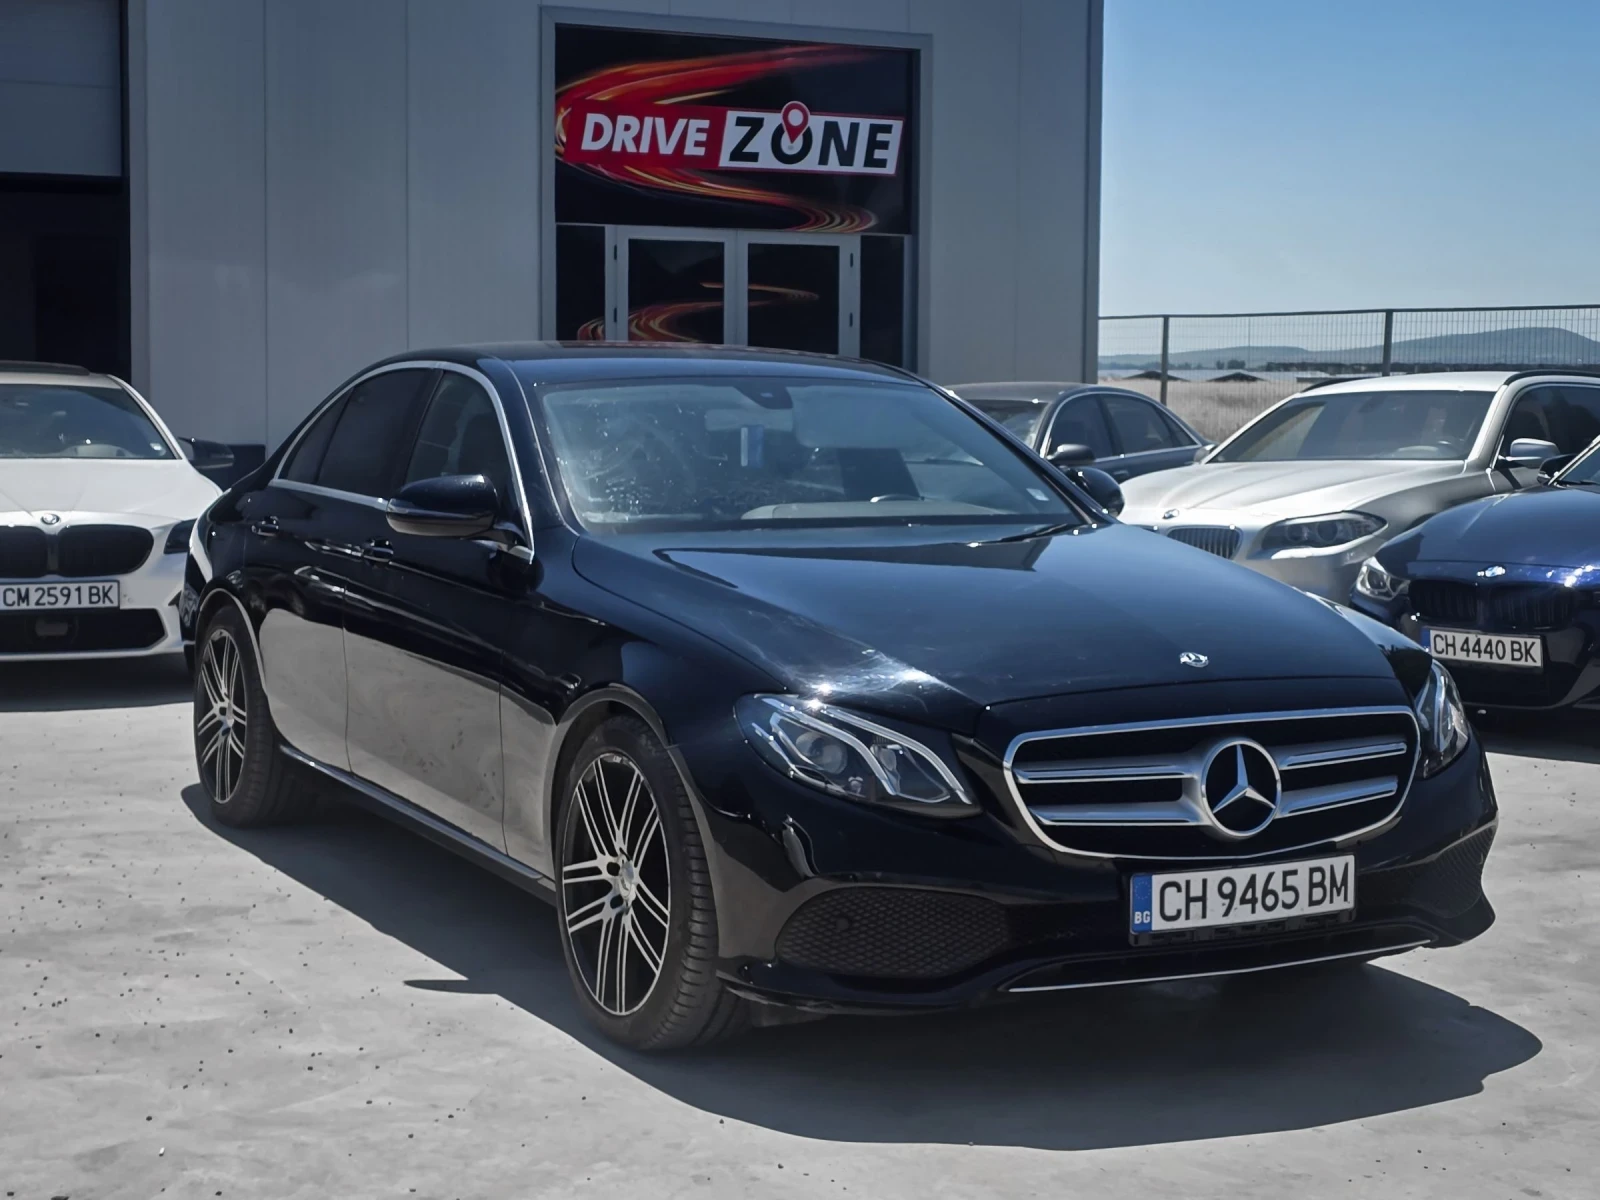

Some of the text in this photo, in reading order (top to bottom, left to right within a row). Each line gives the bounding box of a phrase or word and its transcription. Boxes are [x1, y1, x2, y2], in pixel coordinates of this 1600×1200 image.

[580, 111, 895, 169] DRIVE ZONE
[2, 584, 114, 607] CM 2591 BK
[1433, 633, 1537, 663] CH 4440 BK
[1159, 861, 1349, 922] CH 9465 BM
[1133, 911, 1151, 925] BG
